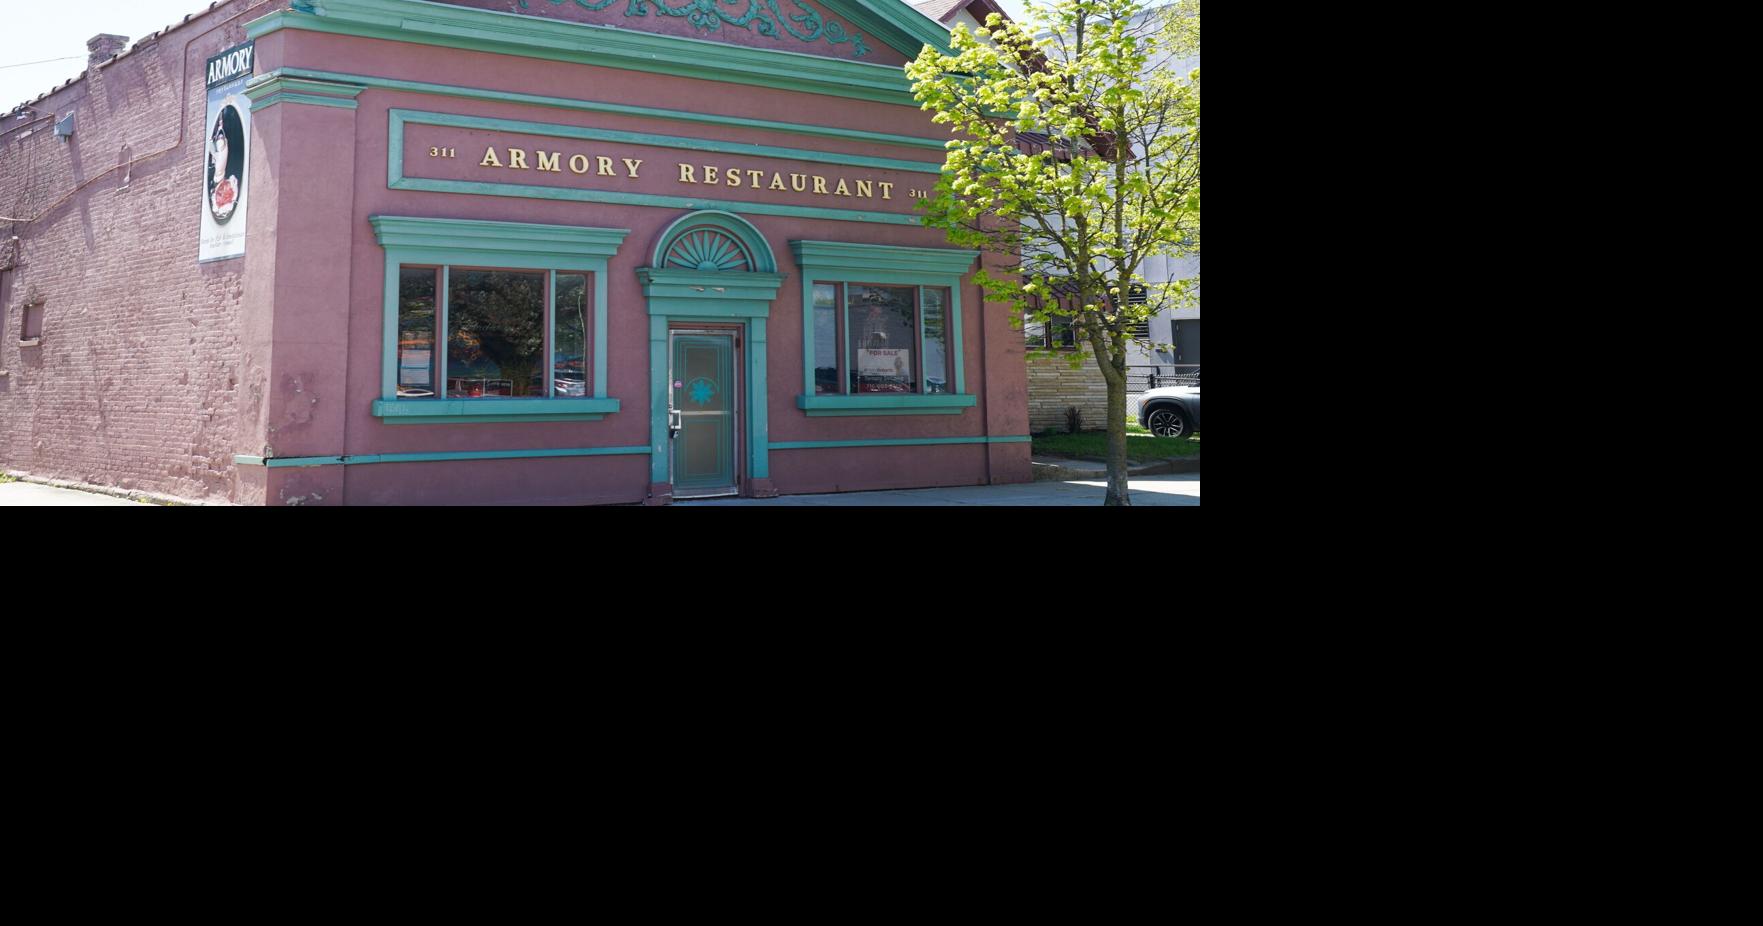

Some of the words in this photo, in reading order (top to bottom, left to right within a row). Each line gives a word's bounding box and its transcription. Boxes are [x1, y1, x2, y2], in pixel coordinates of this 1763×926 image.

[207, 45, 253, 85] ARMORY
[429, 147, 456, 158] 311
[479, 146, 643, 178] ARMORY
[678, 163, 893, 200] RESTAURANT
[908, 188, 928, 199] 311
